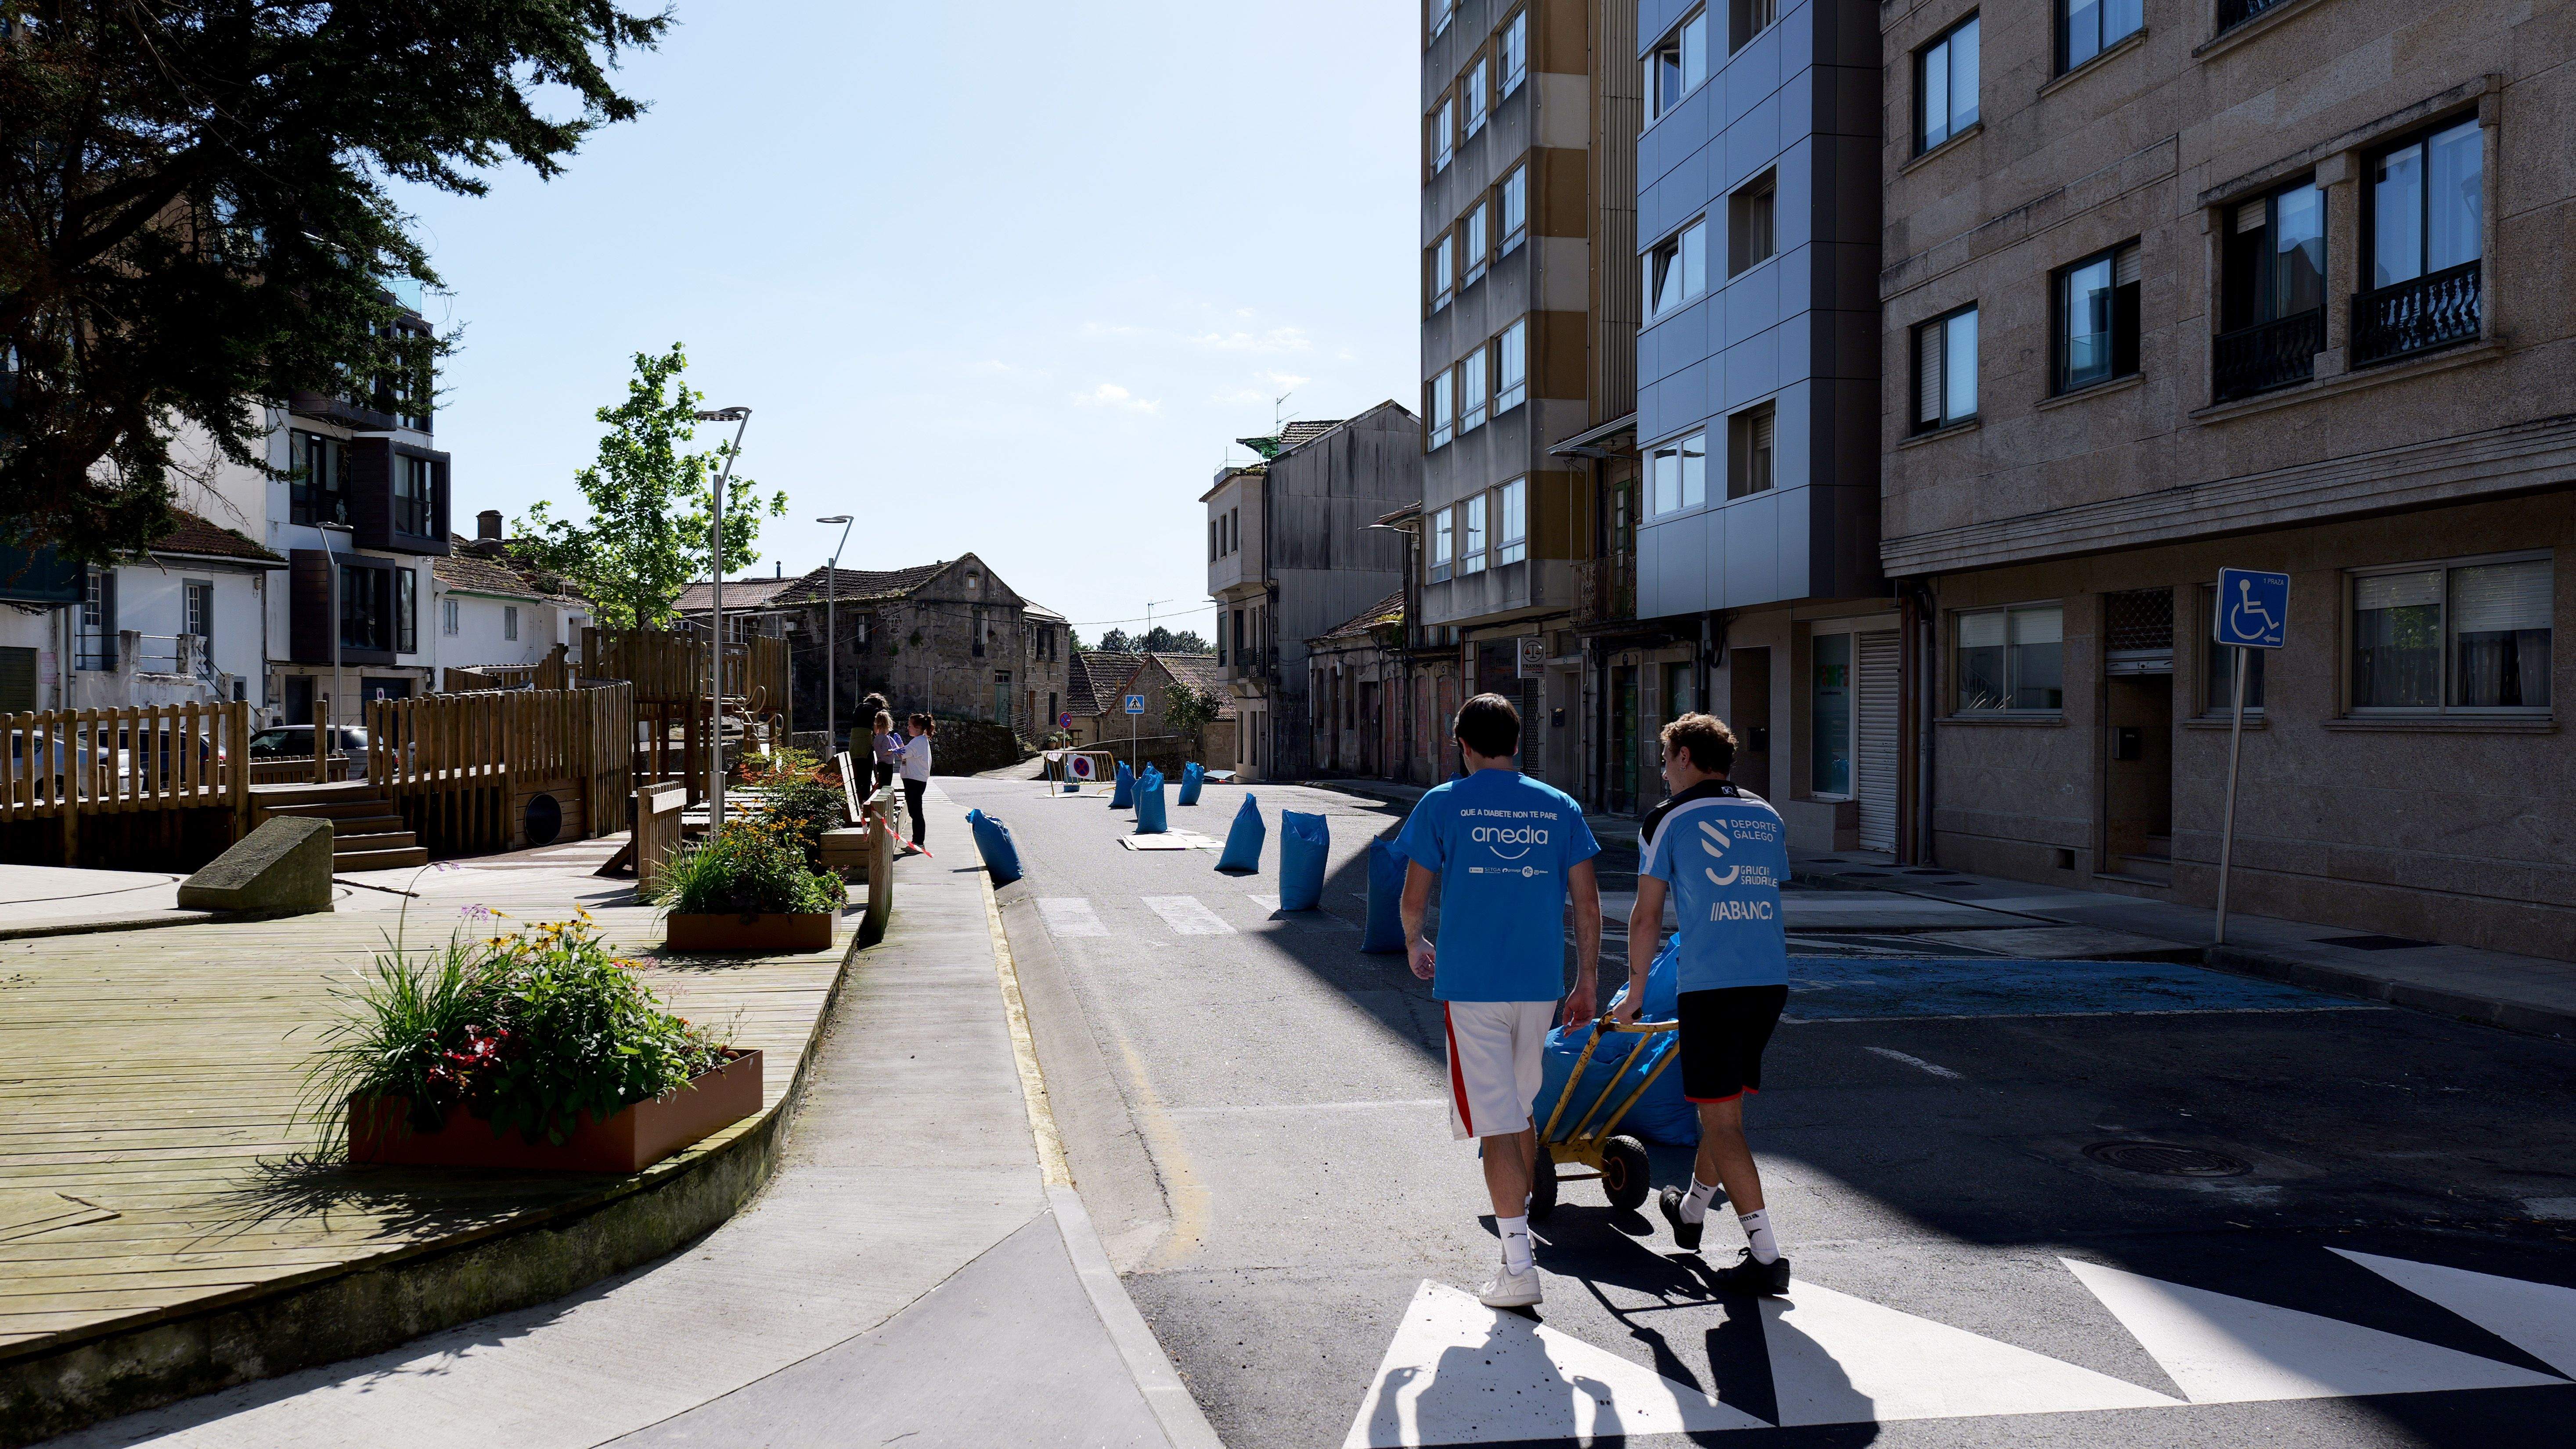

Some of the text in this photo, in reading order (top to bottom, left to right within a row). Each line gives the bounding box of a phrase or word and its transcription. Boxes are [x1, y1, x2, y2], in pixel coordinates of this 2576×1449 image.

[1484, 809, 1511, 818] DIABETE
[1540, 811, 1558, 820] PARE
[1731, 820, 1777, 832] DEPORTE
[1472, 825, 1548, 845] anedia
[1734, 830, 1773, 842] GALEGO
[1740, 876, 1778, 887] SAUDALE
